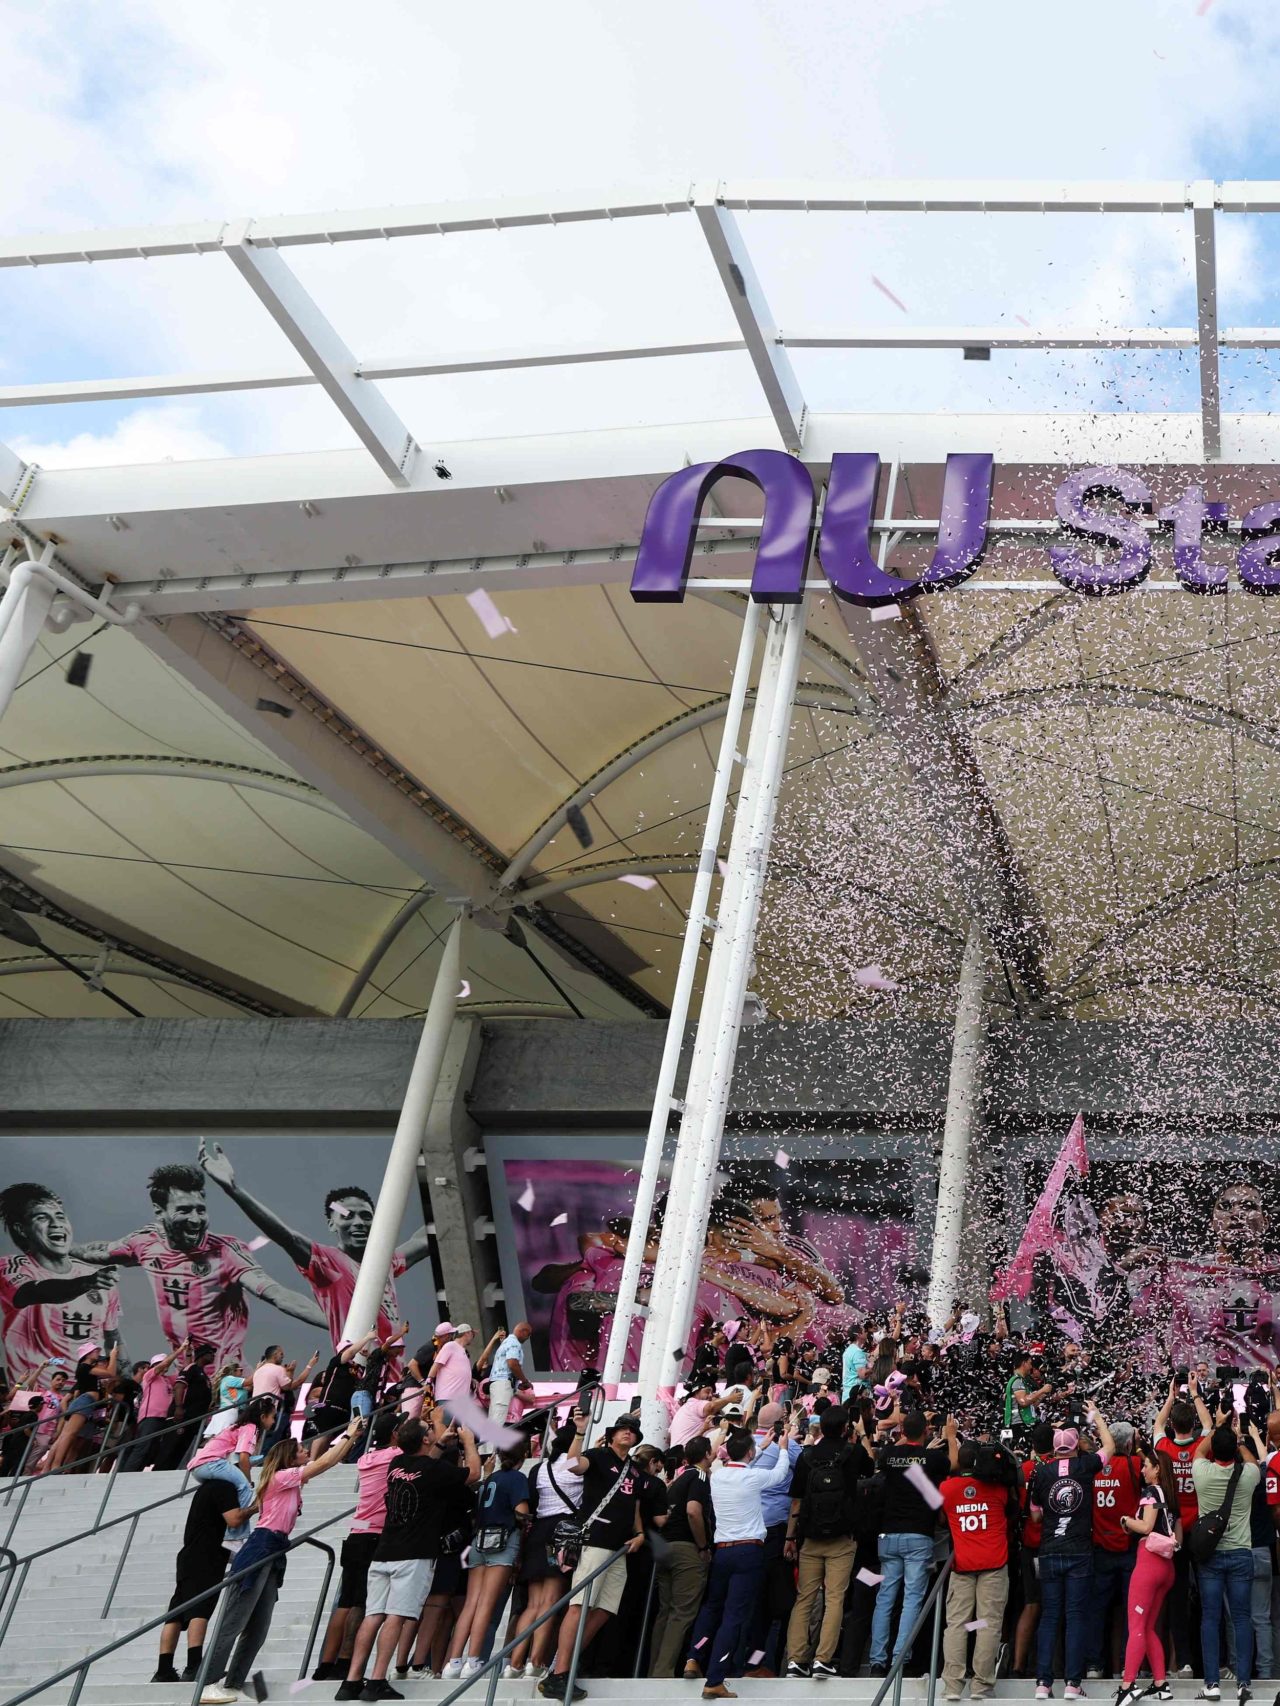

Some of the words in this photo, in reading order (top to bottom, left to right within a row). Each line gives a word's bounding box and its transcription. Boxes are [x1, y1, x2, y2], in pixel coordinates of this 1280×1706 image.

[1094, 1479, 1121, 1488] MEDIA
[1177, 1477, 1195, 1494] 15
[1096, 1490, 1116, 1508] 86
[956, 1503, 989, 1514] MEDIA
[958, 1514, 987, 1532] 101
